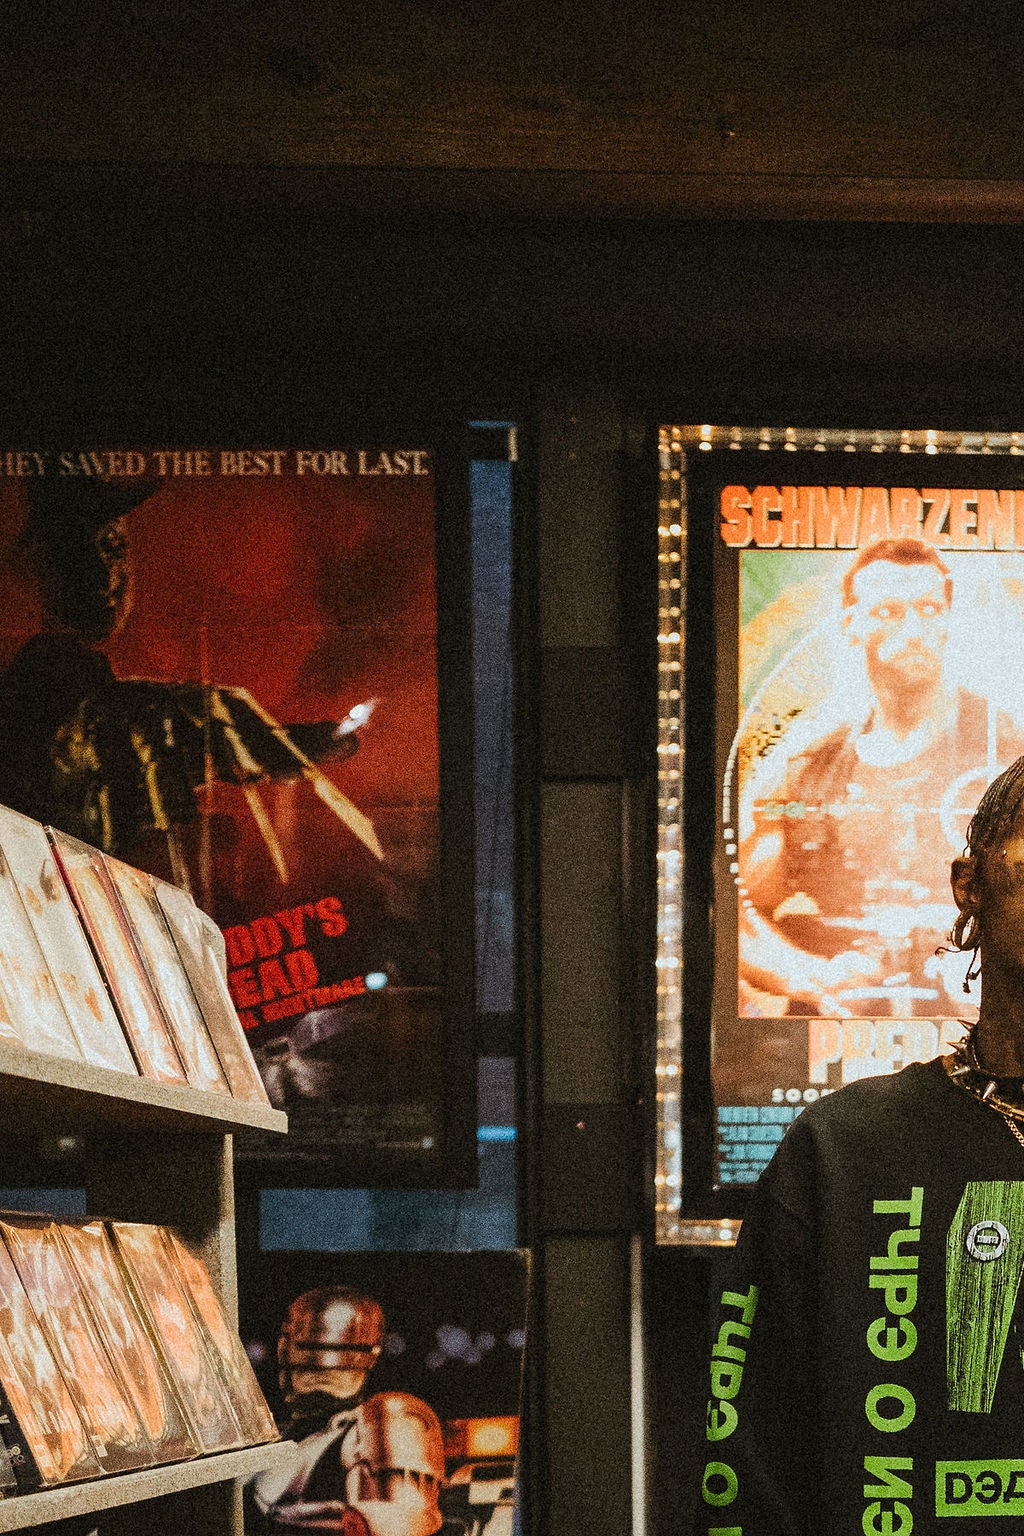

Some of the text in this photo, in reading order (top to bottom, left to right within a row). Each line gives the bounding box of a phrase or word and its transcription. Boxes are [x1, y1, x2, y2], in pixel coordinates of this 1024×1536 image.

[0, 451, 46, 477] HEY
[58, 450, 147, 479] SAVED
[153, 450, 211, 476] THE
[221, 449, 287, 476] BEST
[296, 450, 348, 476] FOR
[221, 896, 349, 968] DDY'S
[227, 949, 320, 1010] EAD
[864, 1382, 918, 1434] O
[702, 1461, 739, 1507] O
